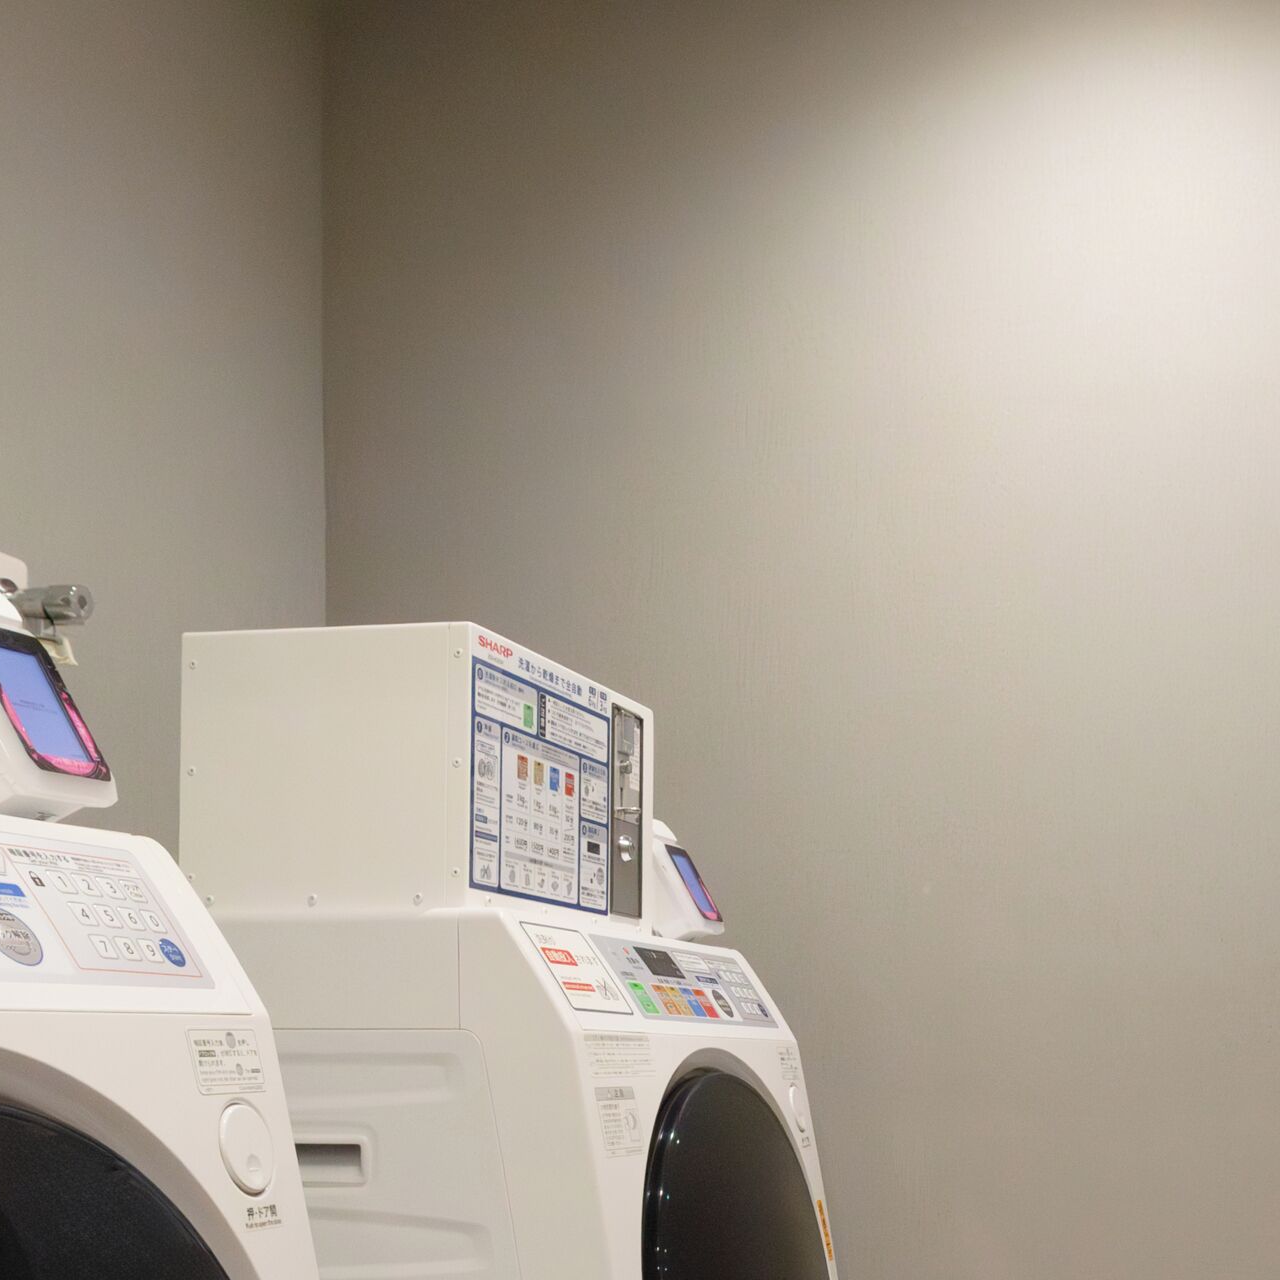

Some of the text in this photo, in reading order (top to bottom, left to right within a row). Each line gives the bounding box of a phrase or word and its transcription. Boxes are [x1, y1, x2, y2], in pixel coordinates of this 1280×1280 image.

[478, 635, 513, 659] SHARP
[58, 875, 67, 888] 1
[82, 879, 93, 891] 2
[105, 882, 117, 894] 3
[81, 908, 90, 919] 4
[103, 910, 114, 922] 5
[127, 912, 137, 925] 6
[150, 915, 160, 927] 0
[99, 940, 108, 953] 7
[123, 942, 134, 954] 8
[145, 944, 155, 956] 9
